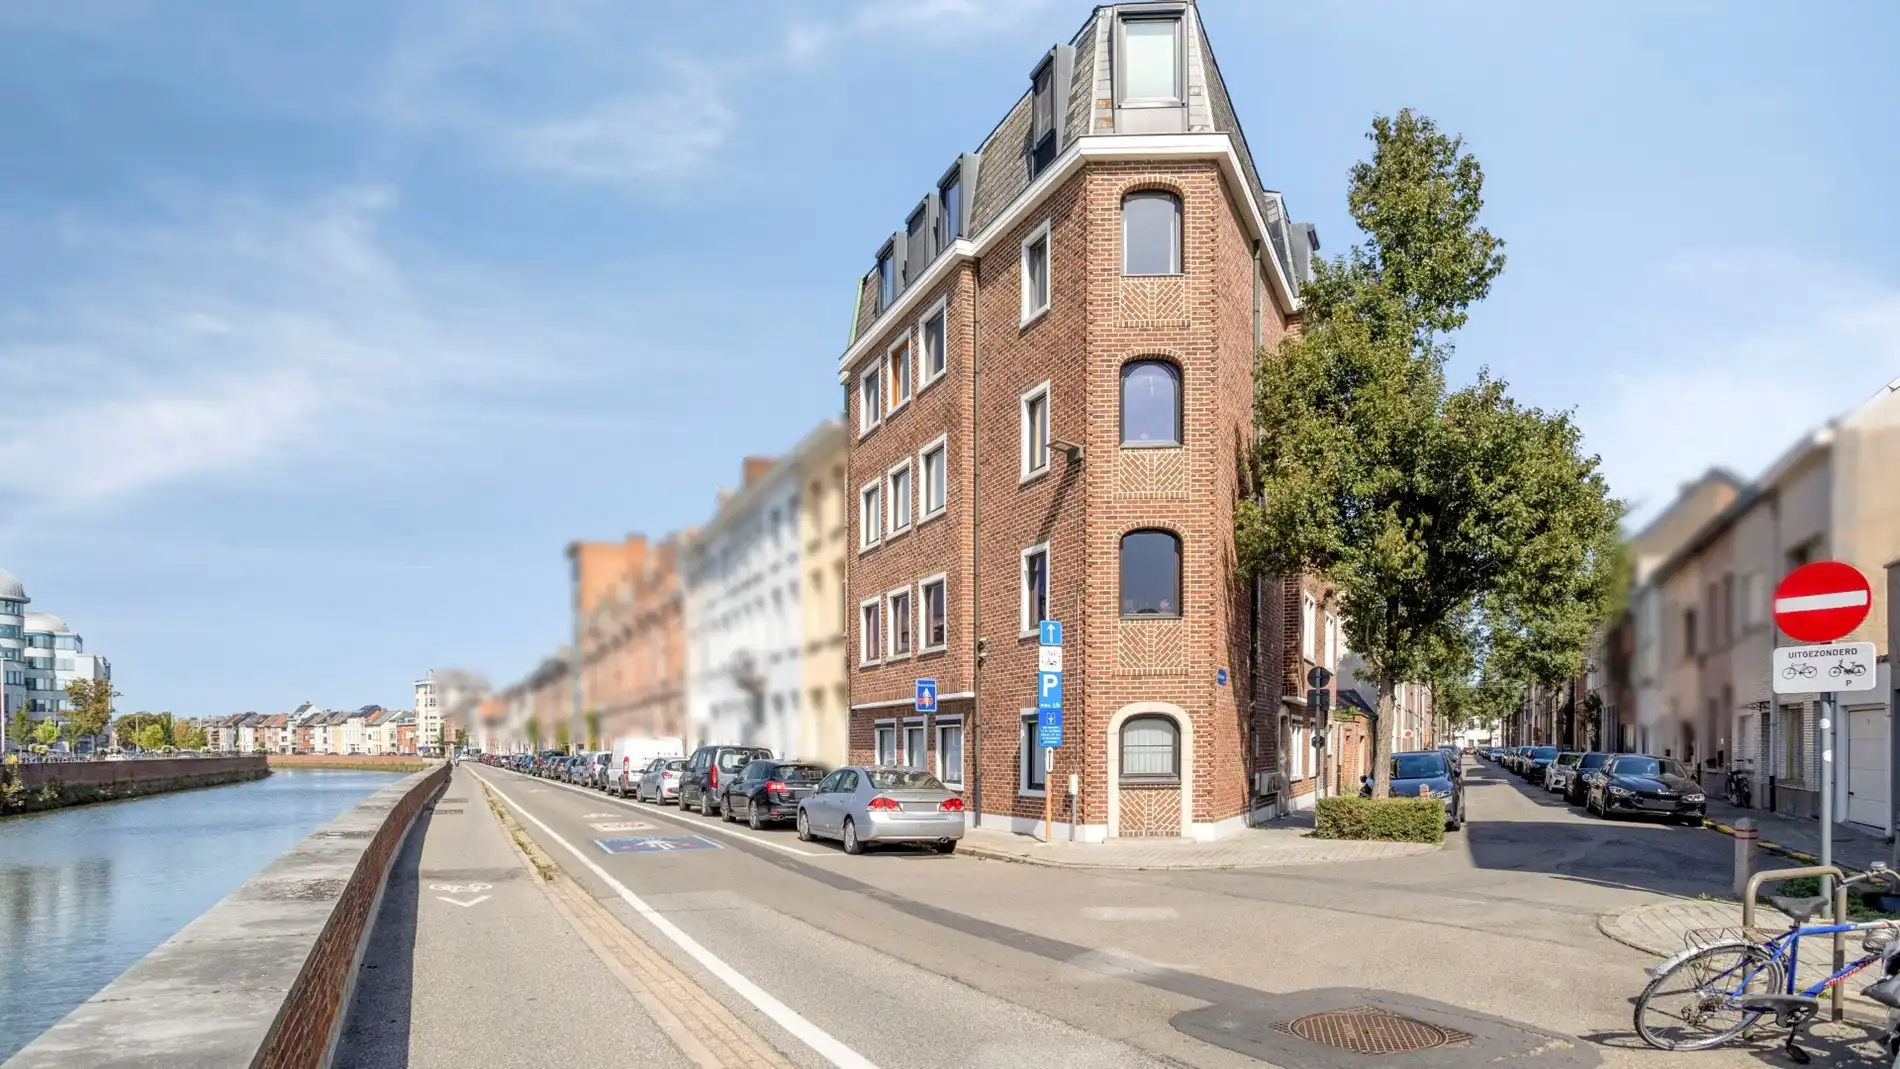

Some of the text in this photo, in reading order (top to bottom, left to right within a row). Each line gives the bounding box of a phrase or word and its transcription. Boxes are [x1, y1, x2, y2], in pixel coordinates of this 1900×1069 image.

[1788, 647, 1858, 658] UITGEZONDERD
[1043, 674, 1058, 697] P
[1846, 679, 1852, 687] P
